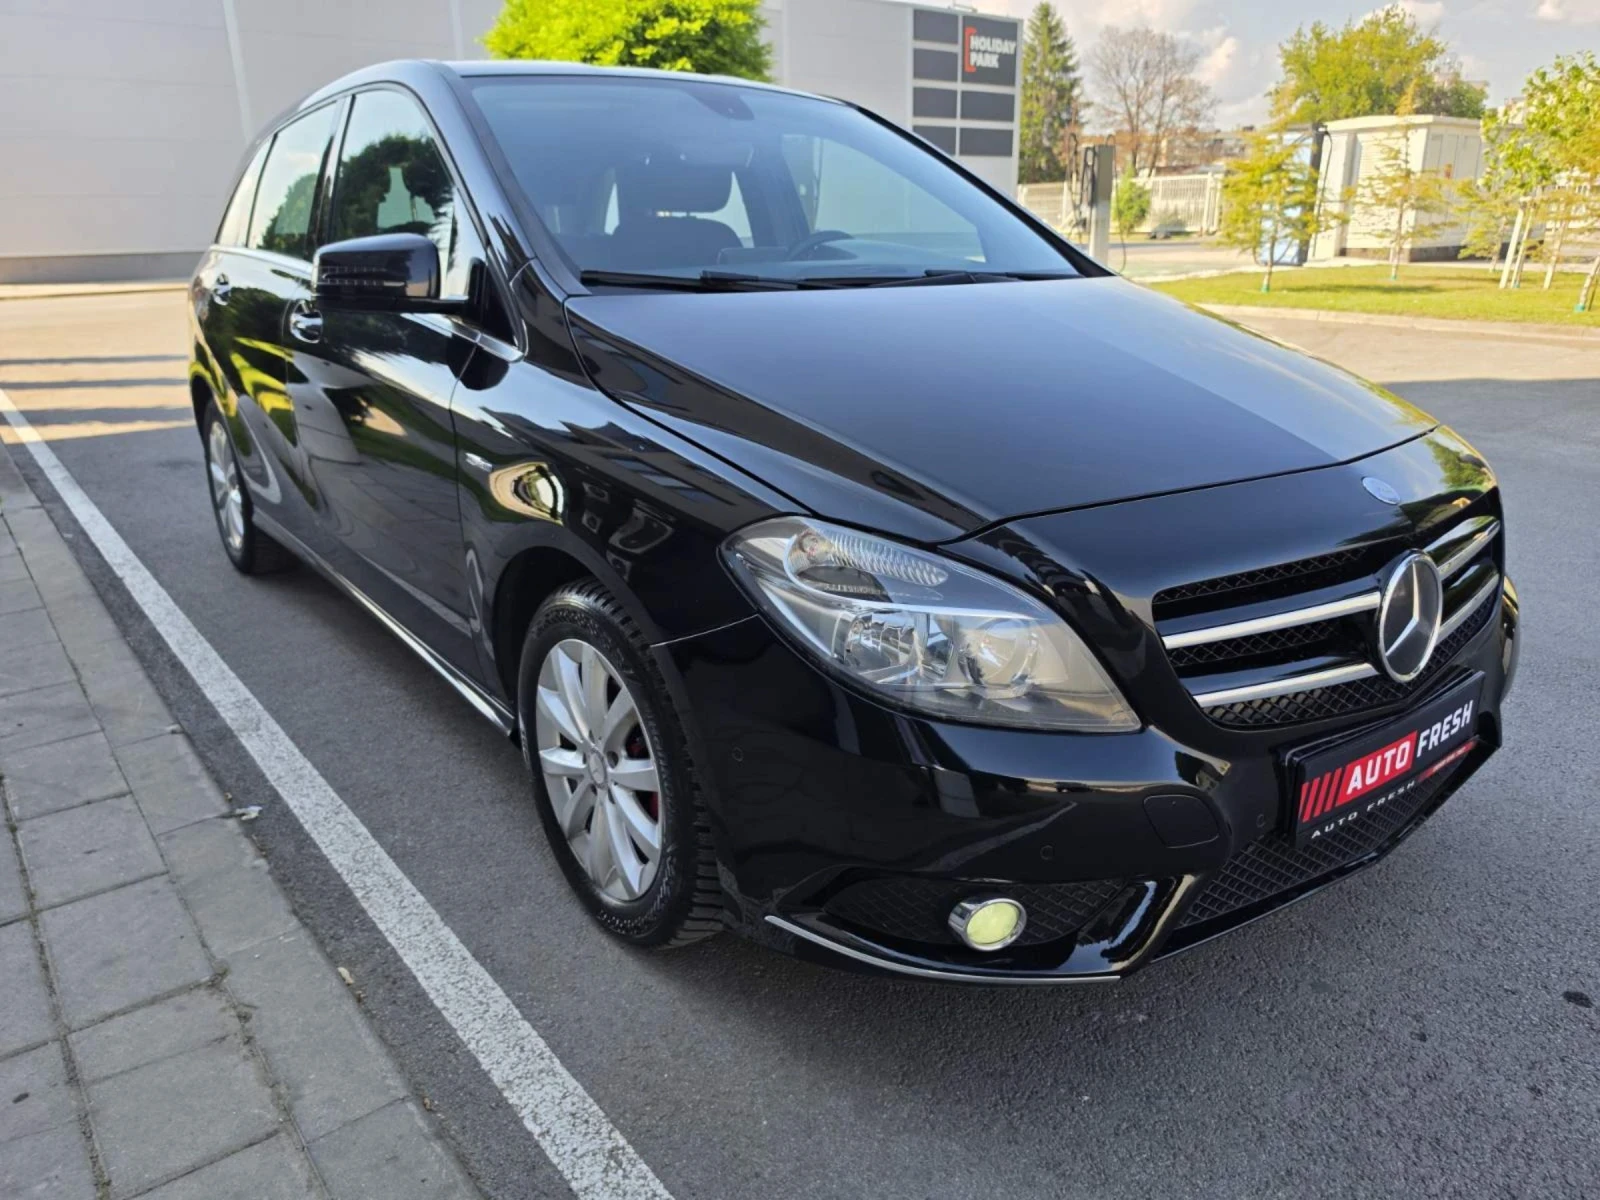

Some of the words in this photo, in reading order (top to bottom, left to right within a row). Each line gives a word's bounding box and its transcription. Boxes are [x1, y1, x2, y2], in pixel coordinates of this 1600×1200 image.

[970, 35, 1016, 55] HOLIDAY
[970, 53, 999, 69] PARK
[1346, 740, 1411, 795] AUTO
[1416, 699, 1474, 758] FRESH
[1311, 812, 1358, 839] AUTO
[1366, 780, 1416, 812] FRESH
